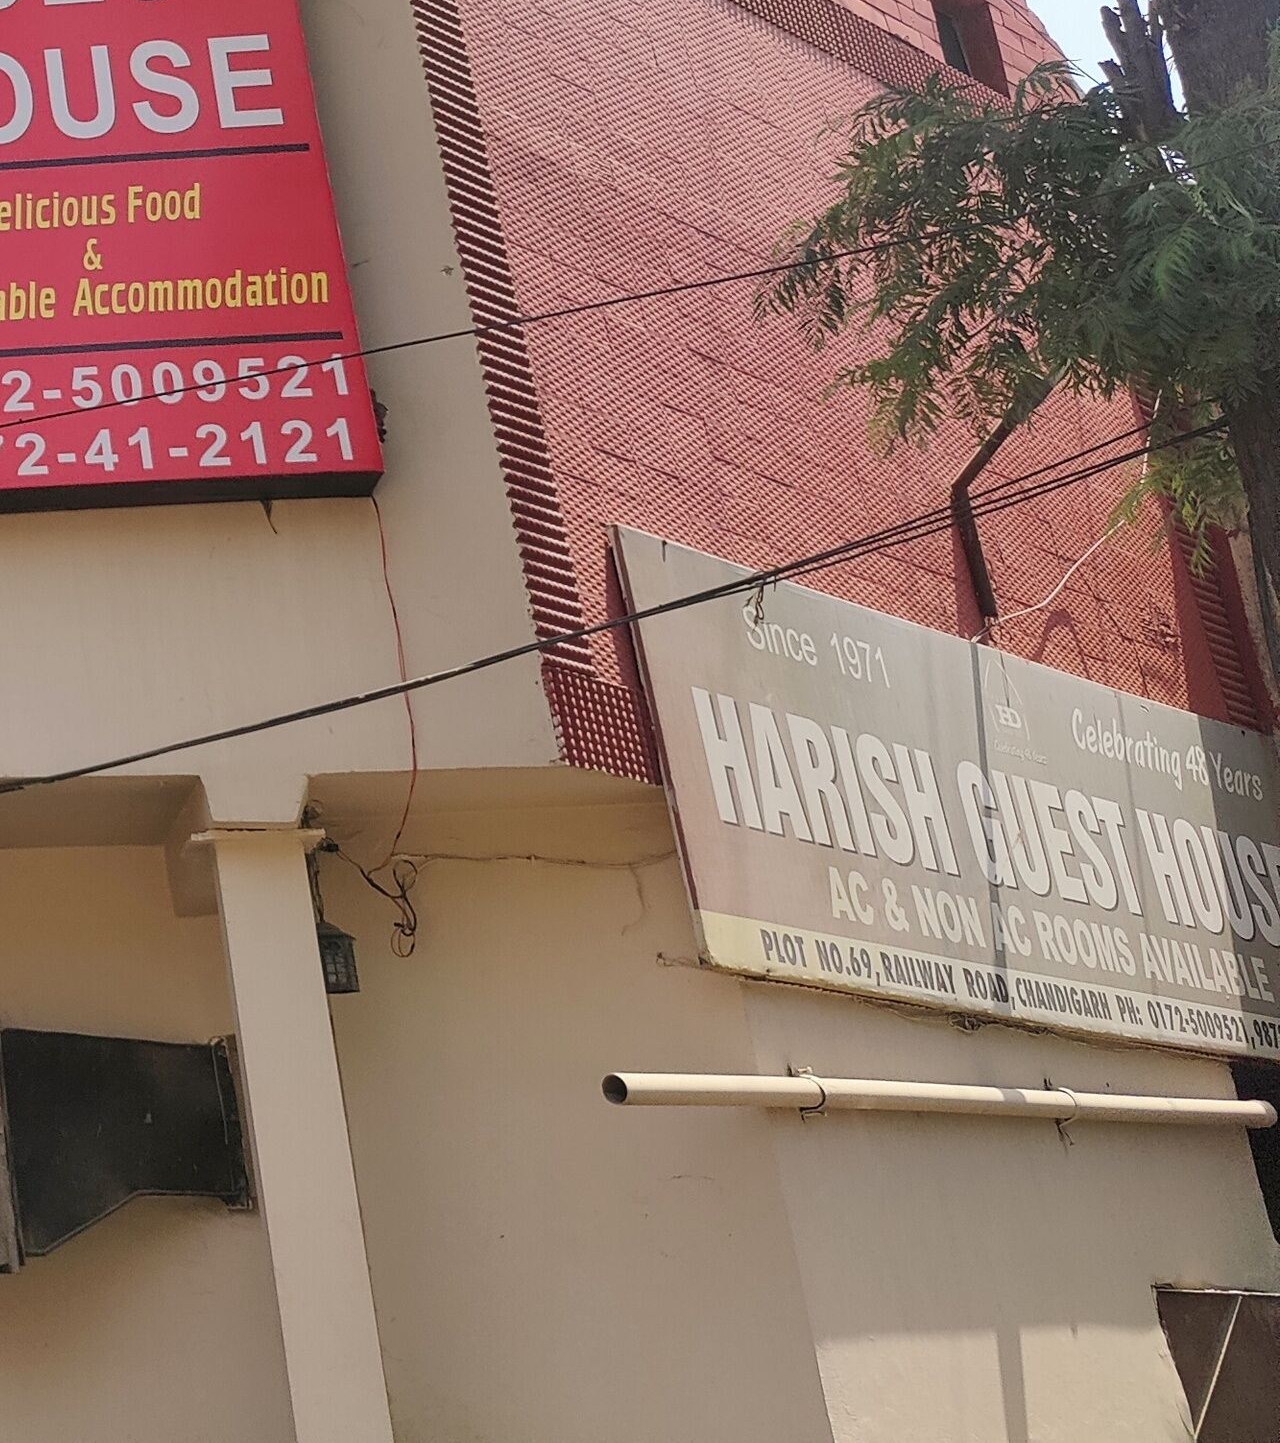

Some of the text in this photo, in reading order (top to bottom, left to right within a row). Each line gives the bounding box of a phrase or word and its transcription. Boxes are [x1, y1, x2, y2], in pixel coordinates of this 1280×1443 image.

[127, 182, 202, 224] Food
[72, 267, 330, 317] Accommodation
[82, 237, 104, 271] &
[743, 606, 891, 688] Since 1971
[1072, 708, 1183, 792] Celebrating
[1208, 751, 1264, 801] Years
[691, 686, 1280, 947] HARISH GUEST HOUS
[760, 928, 808, 968] PLOT
[1114, 994, 1144, 1026] PH:
[828, 866, 1275, 1004] AC & NON AC ROOMS AVAILABLE
